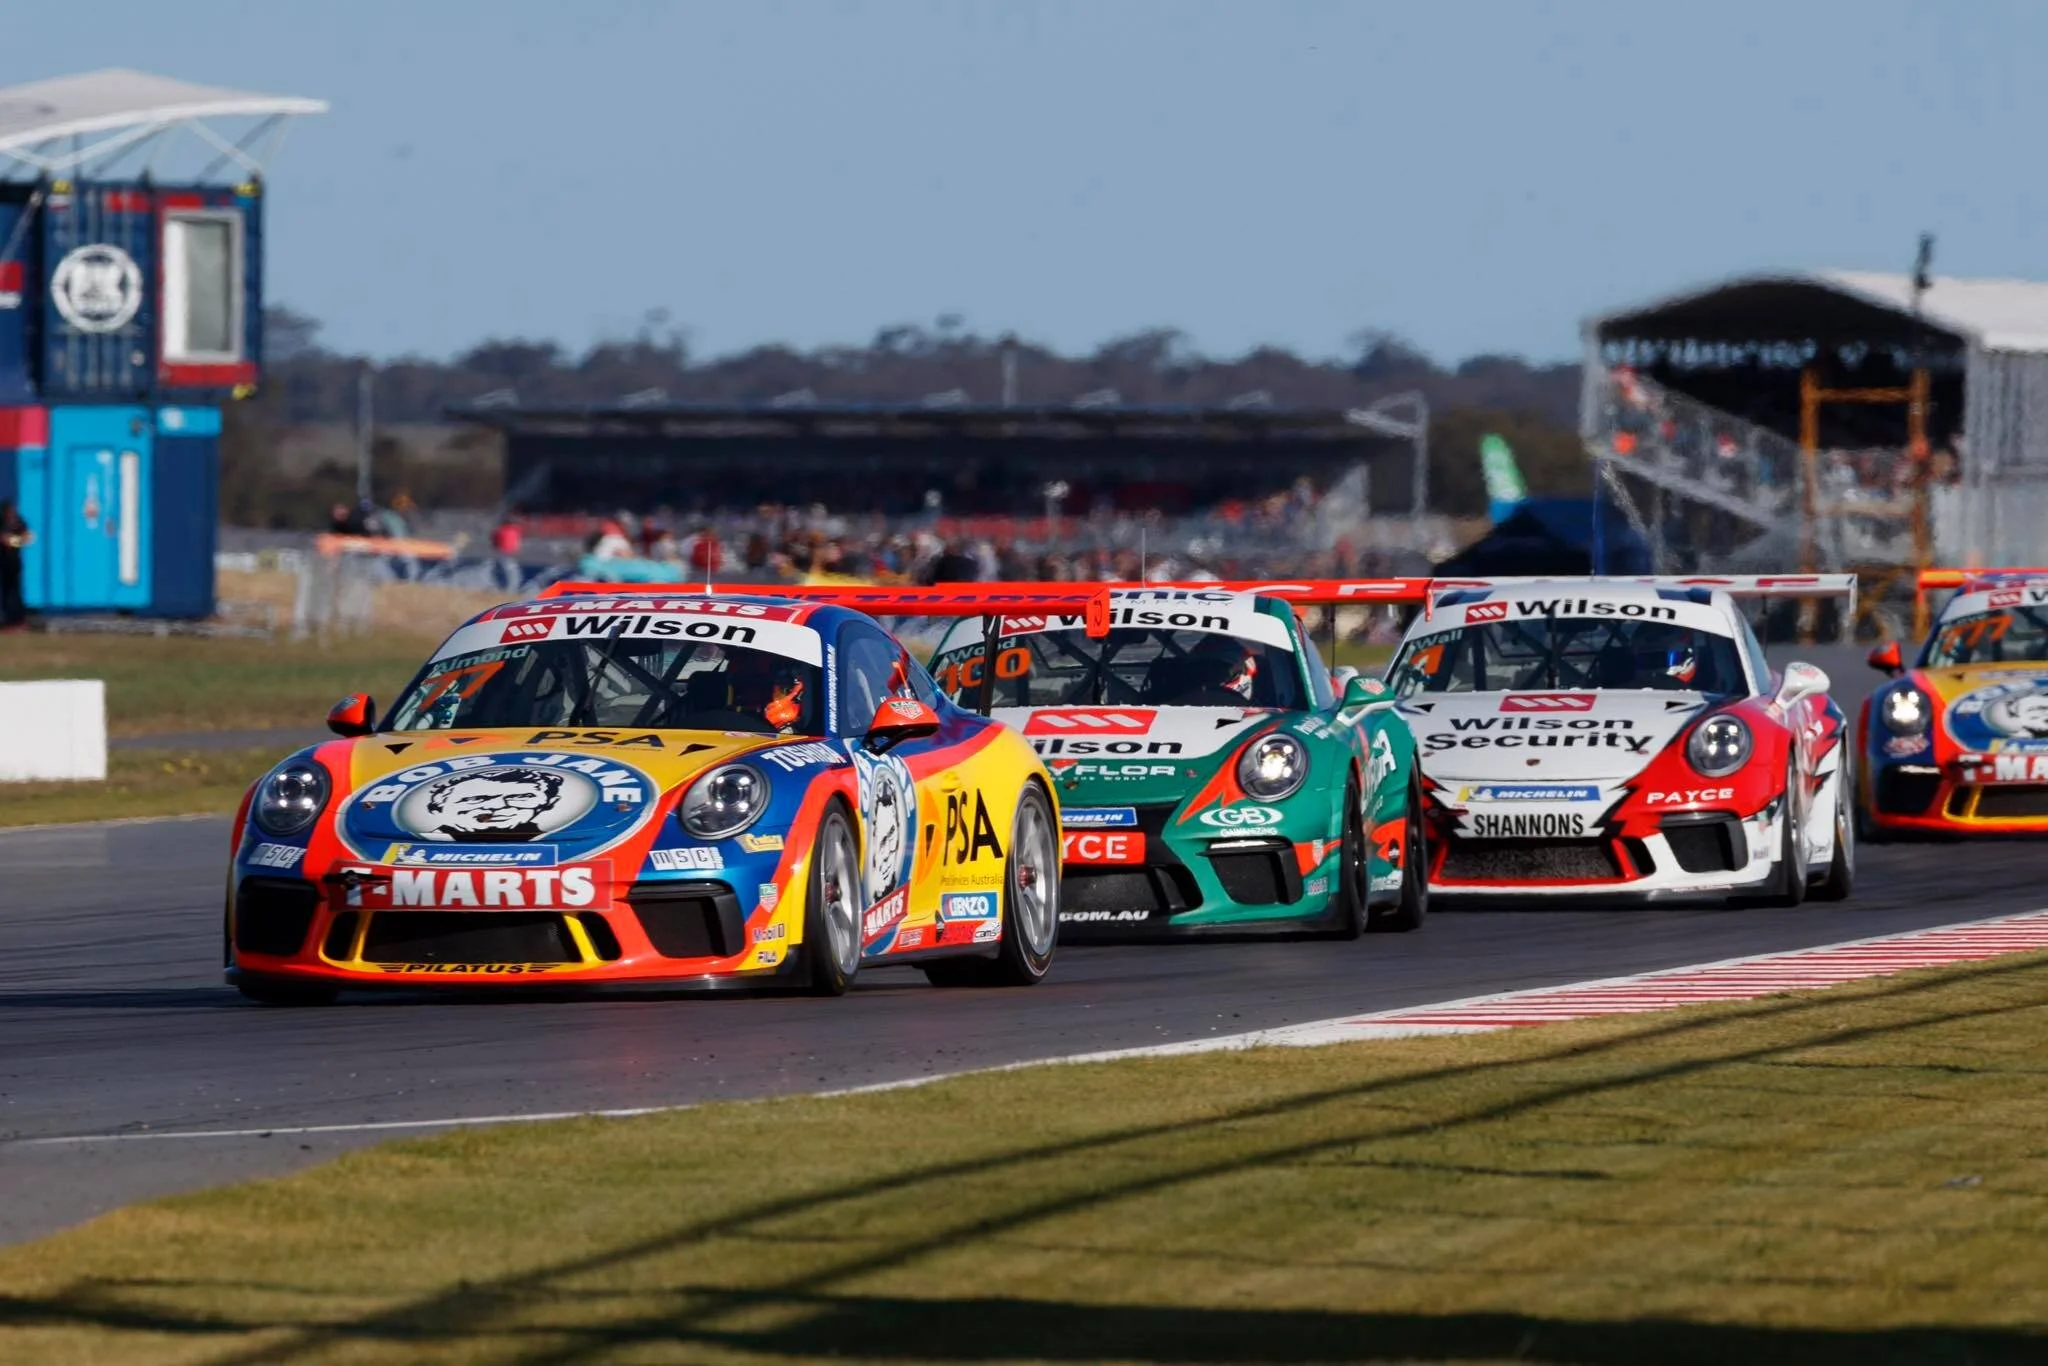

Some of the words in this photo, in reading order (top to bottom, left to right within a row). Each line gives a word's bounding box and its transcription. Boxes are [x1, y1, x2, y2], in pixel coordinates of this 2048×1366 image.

[526, 600, 769, 616] T-MARTS
[1515, 599, 1677, 620] Wilson
[566, 615, 756, 643] Wilson
[948, 637, 1016, 662] Wod
[417, 659, 505, 711] 77
[1450, 717, 1634, 731] Wilson
[526, 731, 665, 748] PSA
[1032, 739, 1182, 754] ilson
[1424, 732, 1654, 752] Security
[362, 755, 496, 803] BOB
[523, 753, 642, 803] JANE
[1049, 764, 1176, 777] YFLOR
[1497, 789, 1588, 799] MICHELIN
[1647, 787, 1735, 804] PAYCE
[943, 788, 1004, 867] PSA
[1474, 813, 1584, 836] SHANNONS
[430, 851, 543, 863] MICHELIN
[1062, 835, 1128, 860] YCE
[340, 867, 596, 907] T-MARTS
[405, 963, 526, 974] PILATUS
